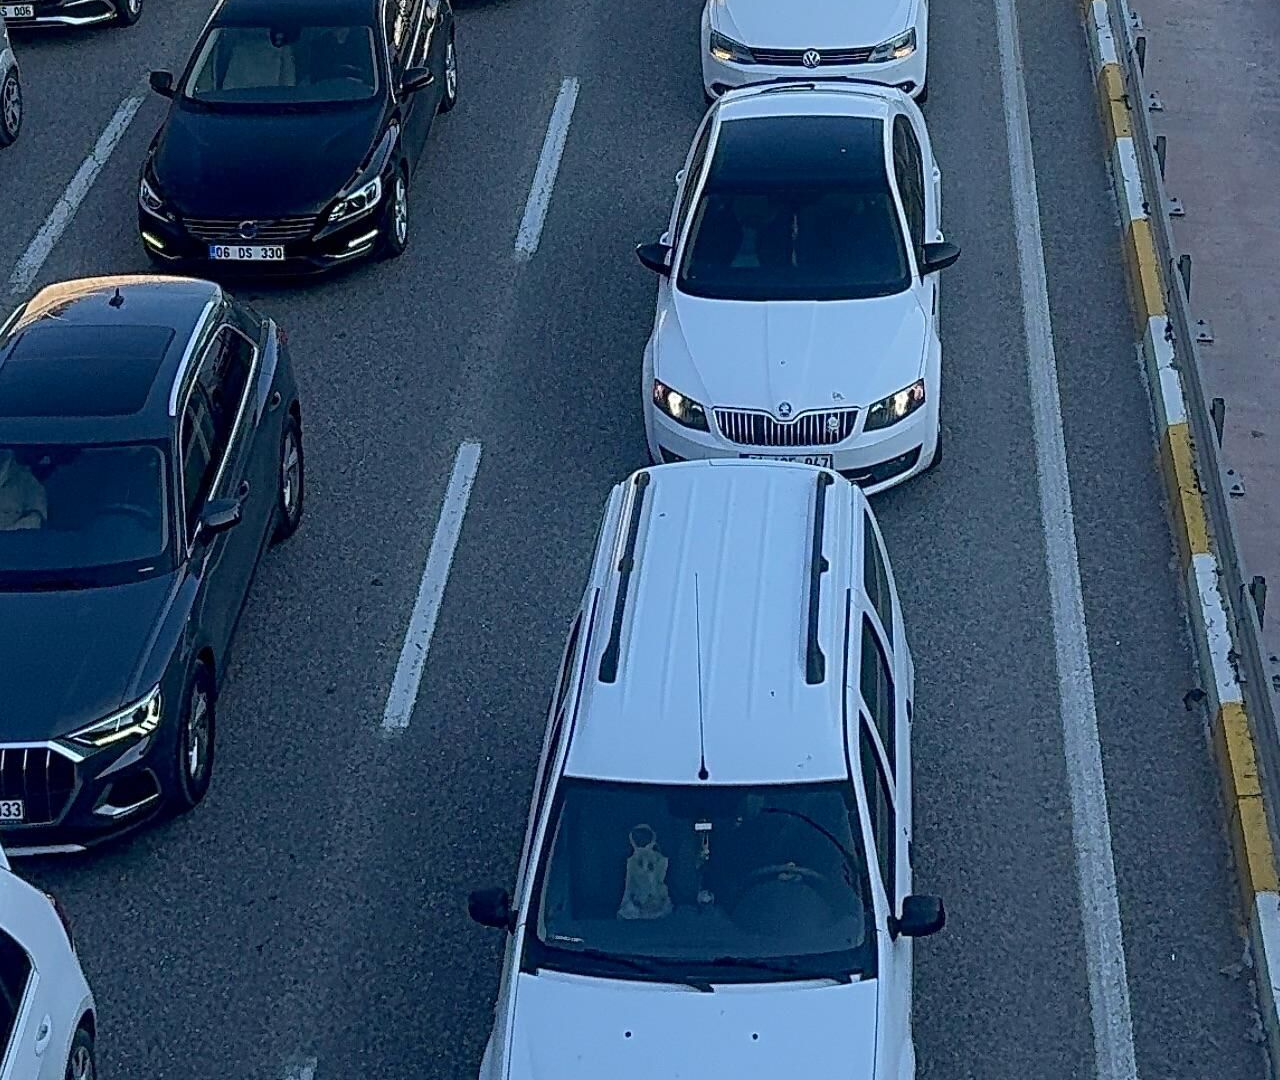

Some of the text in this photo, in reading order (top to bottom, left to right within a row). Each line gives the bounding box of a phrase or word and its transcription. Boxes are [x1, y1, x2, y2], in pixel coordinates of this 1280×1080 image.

[216, 246, 283, 259] 06 DS 330
